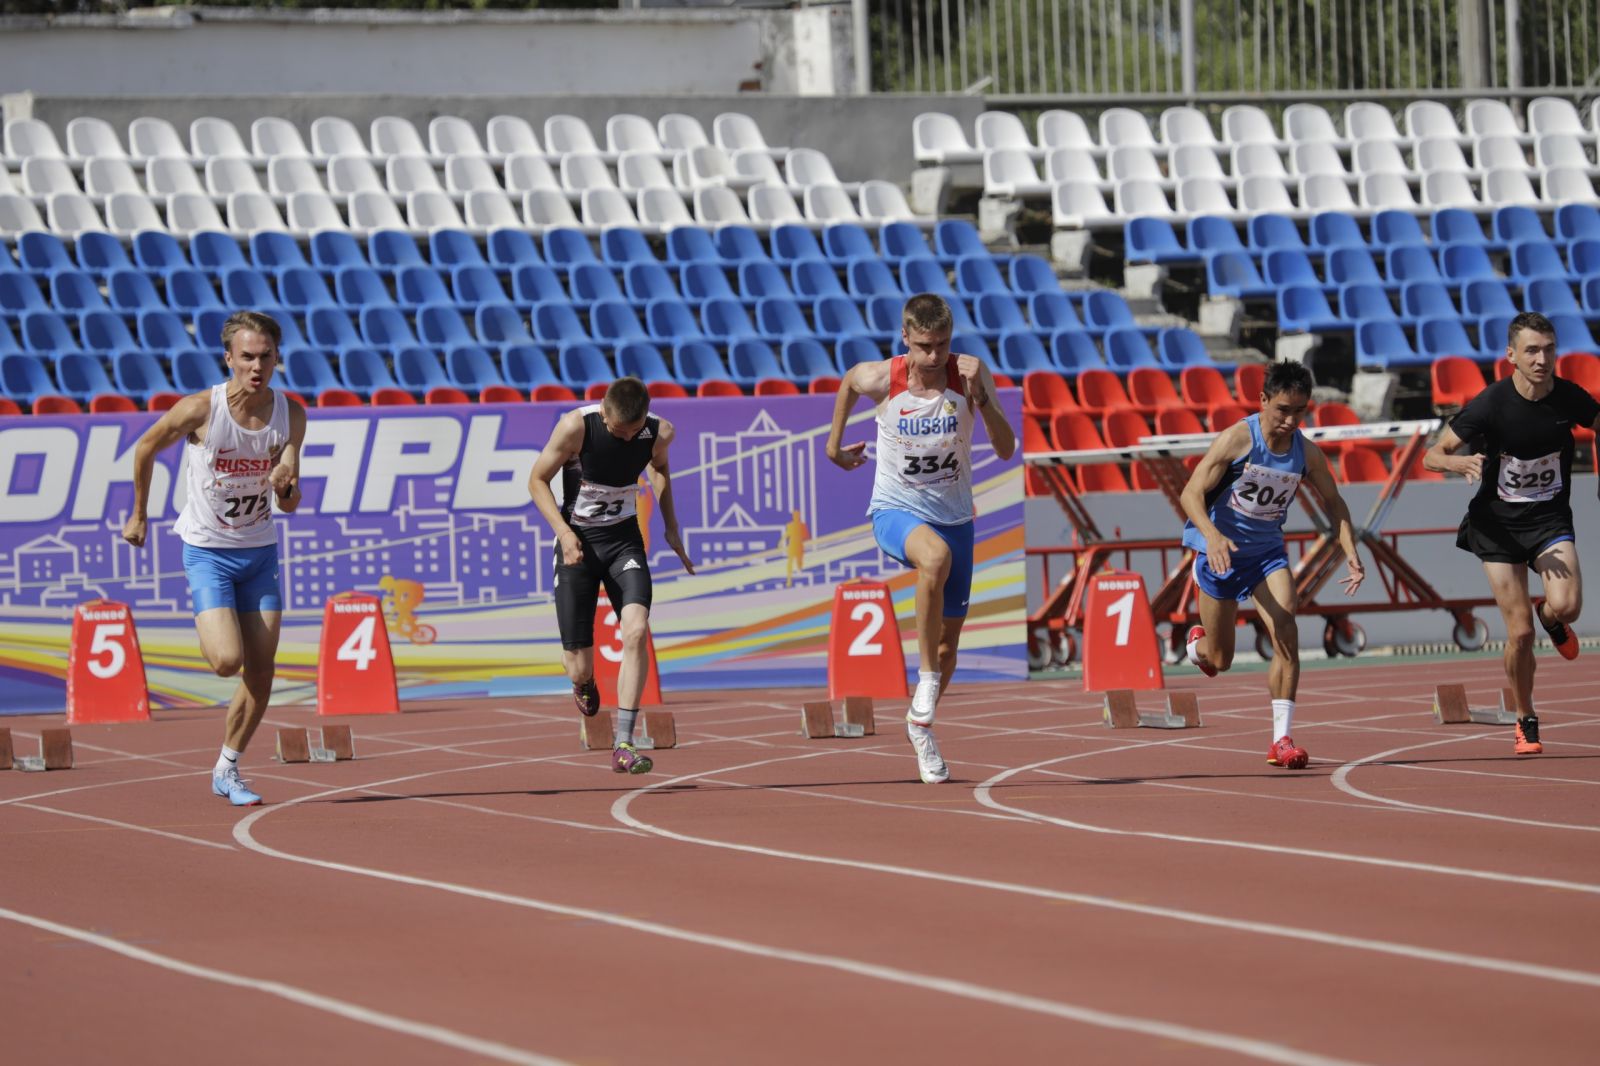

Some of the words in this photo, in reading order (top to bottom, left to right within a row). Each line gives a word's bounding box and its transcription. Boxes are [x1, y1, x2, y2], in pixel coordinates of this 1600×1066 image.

[897, 416, 958, 435] RUSSIA
[904, 452, 959, 475] 334
[1505, 469, 1556, 489] 329
[225, 490, 268, 518] 275
[1238, 482, 1289, 507] 204
[589, 499, 625, 517] 23
[843, 590, 885, 600] MONDO
[1098, 580, 1140, 591] MONDO
[82, 610, 127, 621] MONDO
[334, 603, 377, 613] MONDO
[1106, 592, 1135, 646] 1
[600, 611, 624, 662] 3
[848, 602, 885, 656] 2
[88, 623, 126, 679] 5
[337, 616, 377, 670] 4
